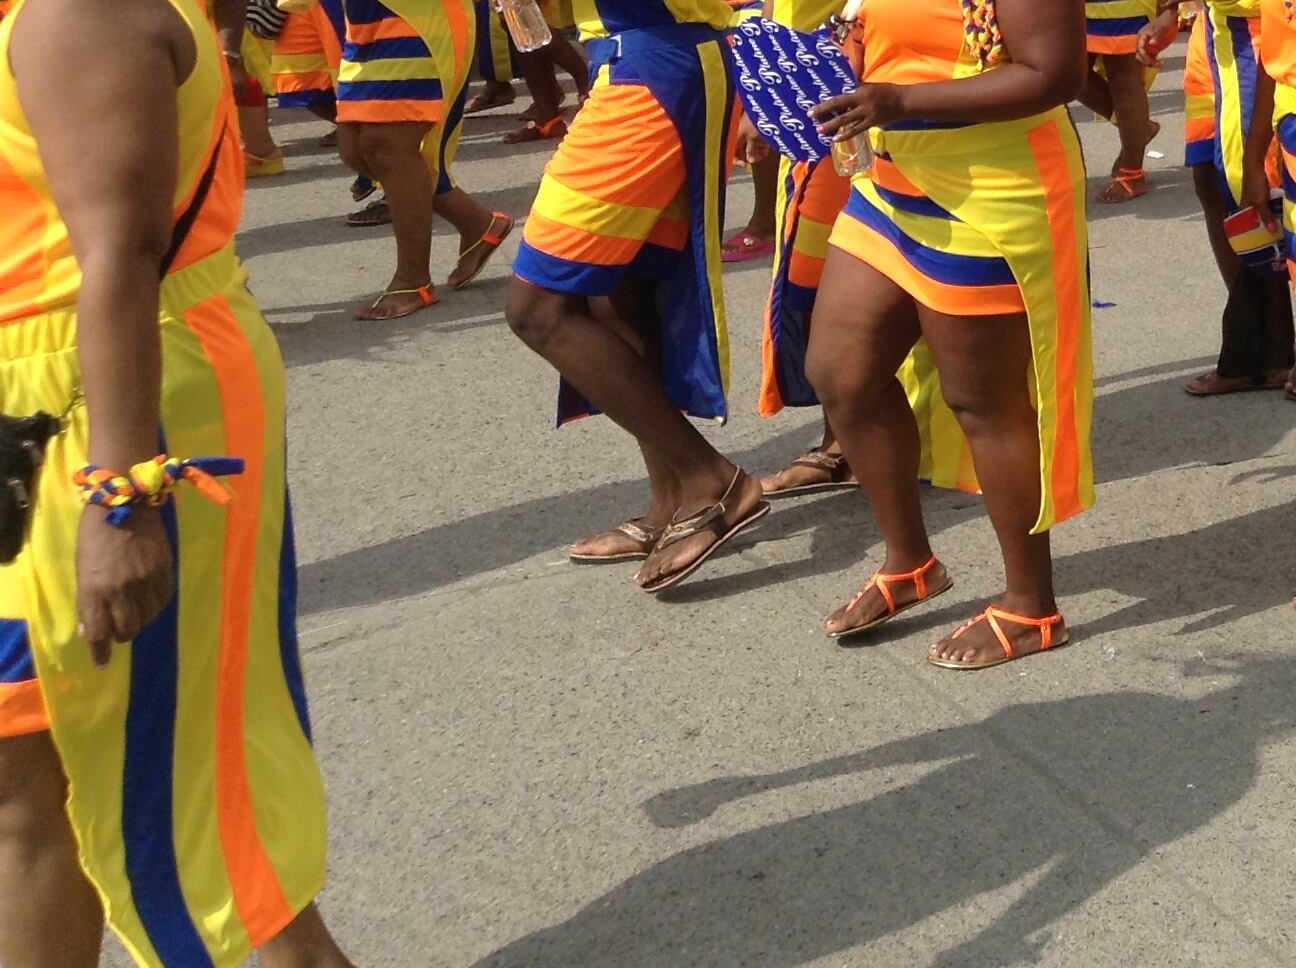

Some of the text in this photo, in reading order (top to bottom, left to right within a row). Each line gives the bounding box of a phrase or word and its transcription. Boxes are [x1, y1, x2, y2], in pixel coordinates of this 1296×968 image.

[731, 47, 761, 92] Platino
[748, 38, 782, 85] Platino
[768, 34, 798, 73] Platino
[746, 94, 780, 137] Platino
[767, 87, 805, 132] Platino
